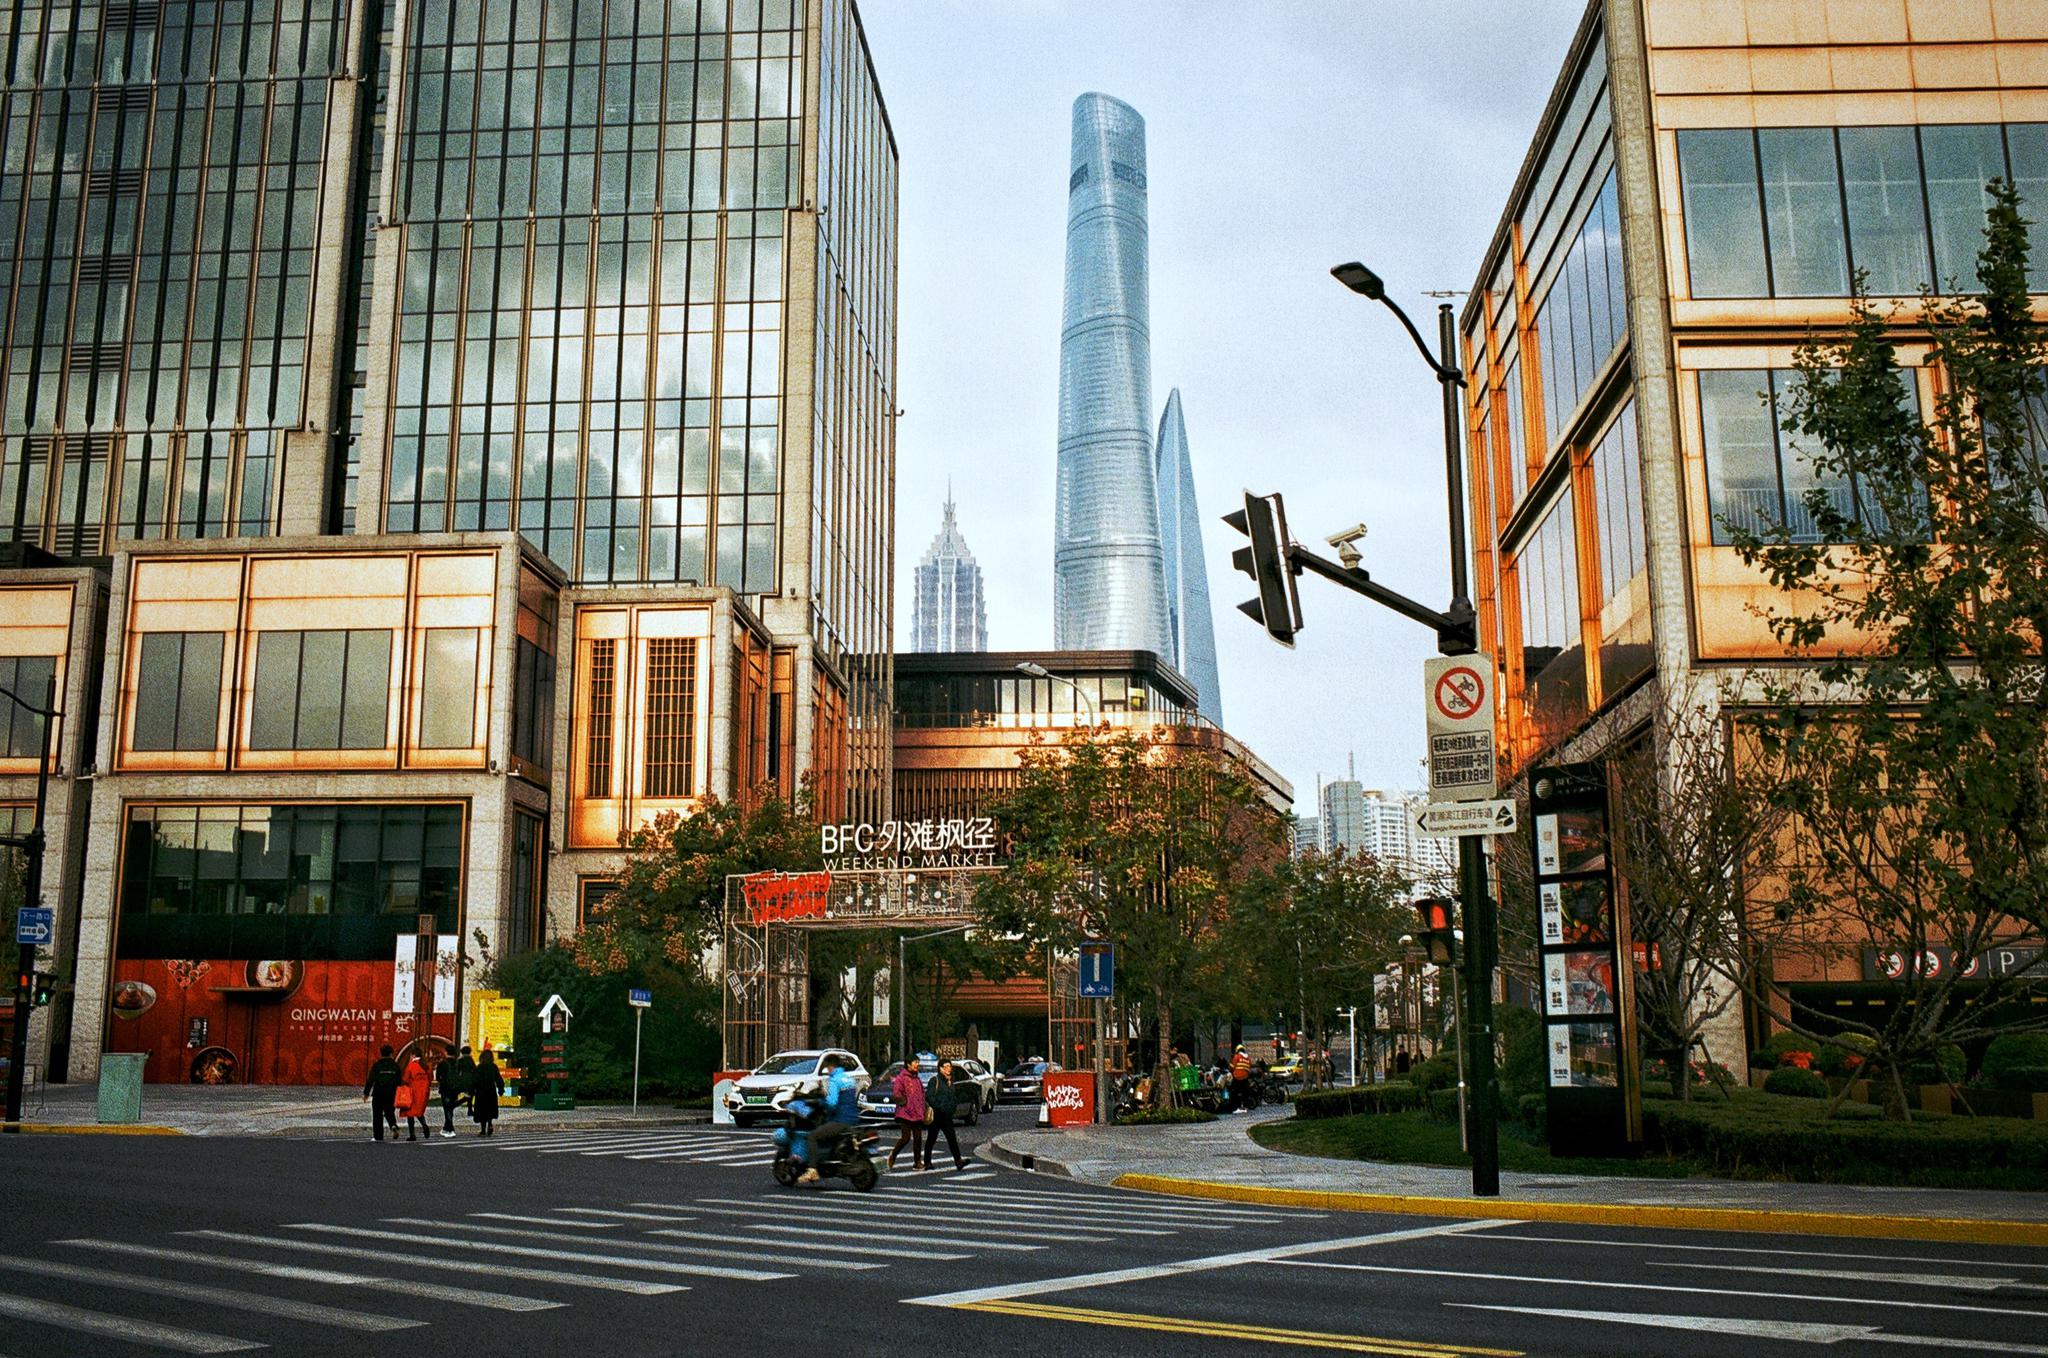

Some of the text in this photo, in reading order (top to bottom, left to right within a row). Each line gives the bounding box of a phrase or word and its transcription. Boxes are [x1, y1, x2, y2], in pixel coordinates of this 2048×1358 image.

[821, 816, 997, 854] BFC 外滩枫径
[822, 852, 997, 872] WEEKEND MARKET
[22, 911, 50, 920] 下一路口
[2000, 951, 2015, 974] P
[291, 1008, 377, 1021] QINGWATAN
[1047, 1084, 1083, 1099] happy
[1046, 1095, 1084, 1110] holidays
